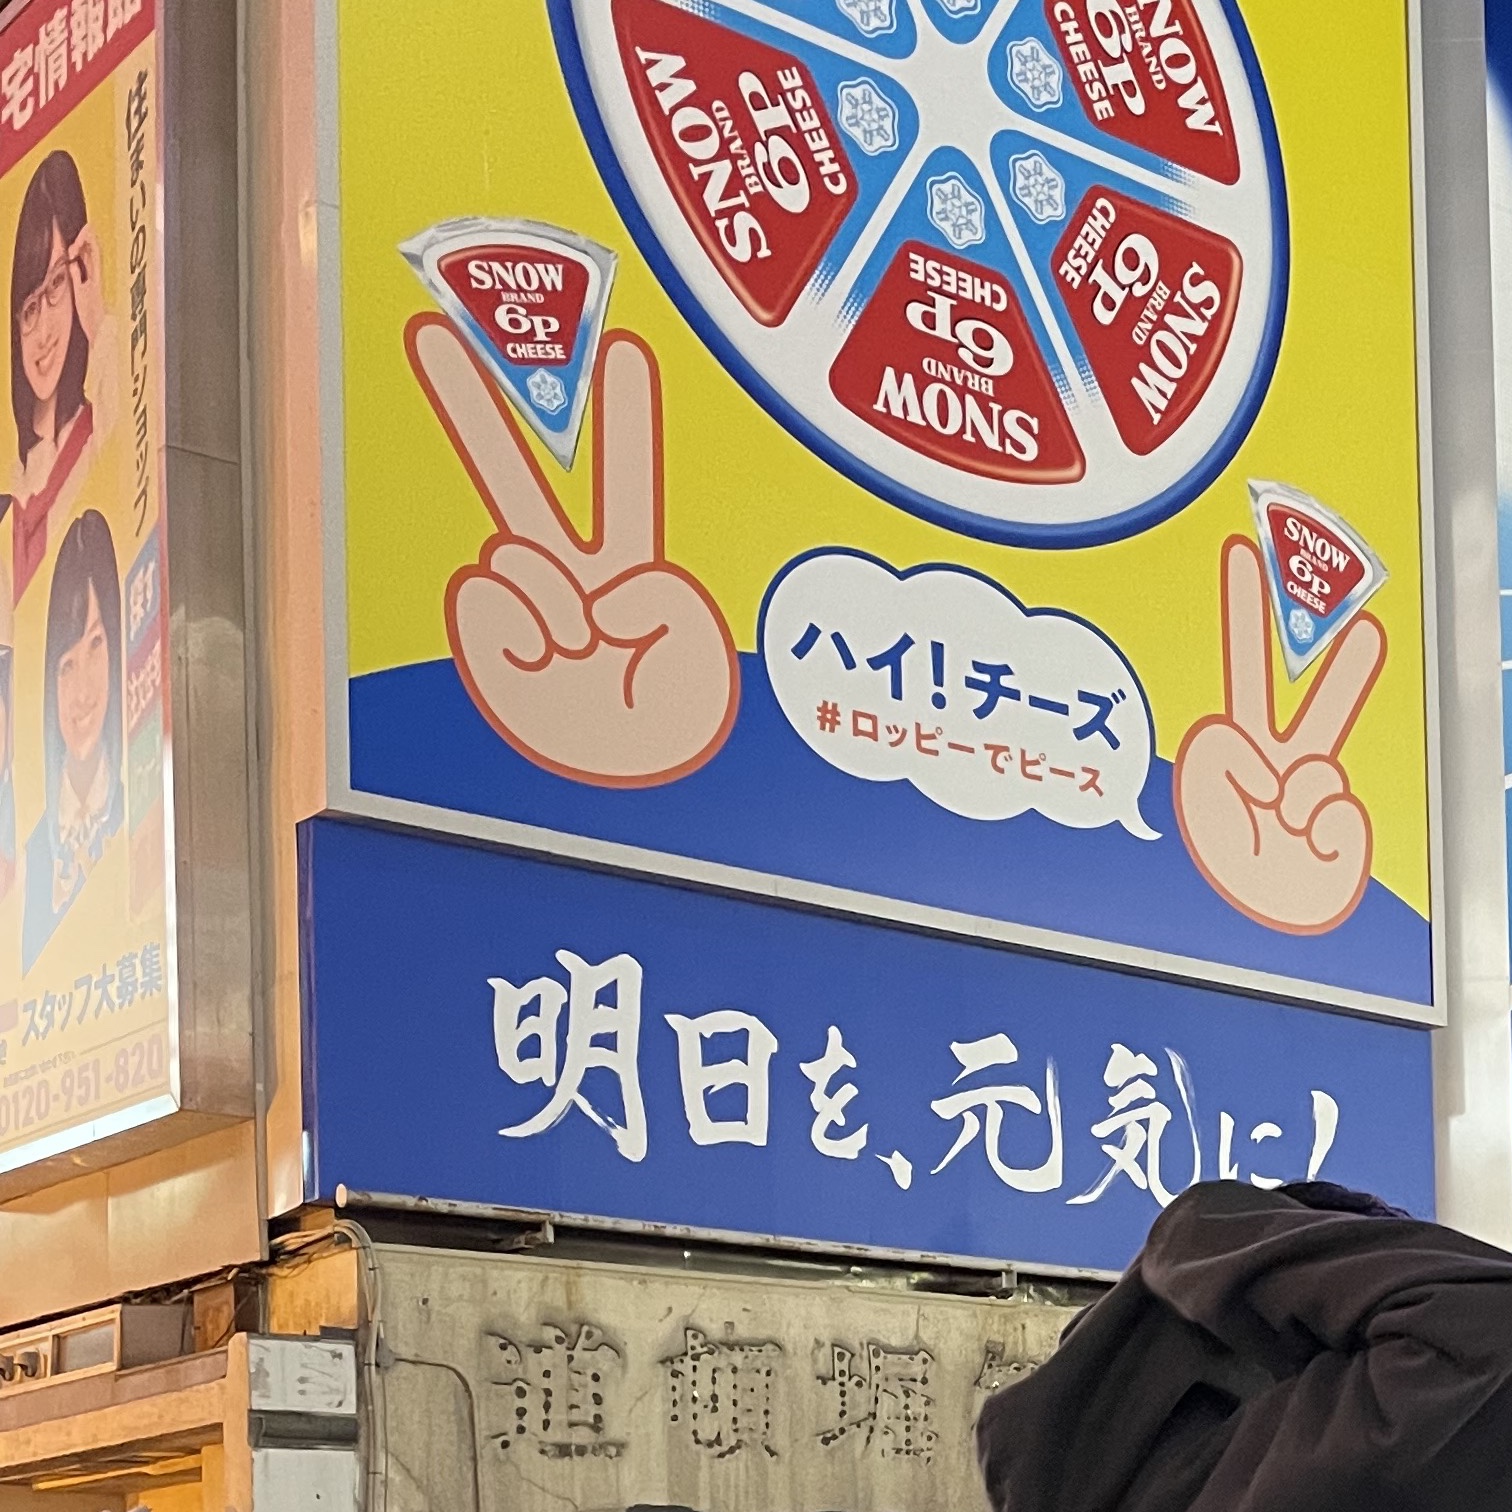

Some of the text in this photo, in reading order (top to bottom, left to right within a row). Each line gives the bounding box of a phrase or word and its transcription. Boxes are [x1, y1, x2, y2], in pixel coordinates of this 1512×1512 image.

[1054, 1, 1115, 121] CHEESE
[1086, 0, 1146, 116] 6P
[1124, 5, 1167, 91] BRAND
[635, 46, 773, 263] SNOW
[711, 100, 764, 196] BRAND
[738, 71, 812, 214] 6P
[776, 65, 846, 196] CHEESE
[467, 260, 564, 292] SNOW
[907, 251, 1008, 312] CHEESE
[1058, 196, 1116, 289] CHEESE
[1091, 233, 1161, 326] 6P
[494, 303, 560, 341] 6P
[500, 290, 545, 304] BRAND
[905, 290, 1014, 377] 6P
[1130, 279, 1171, 346] BRAND
[506, 343, 567, 359] CHEESE
[921, 356, 995, 397] BRAND
[1129, 261, 1221, 426] SNOW
[872, 365, 1040, 463] SNOW
[1283, 516, 1351, 573] SNOW
[1288, 555, 1331, 598] 6P
[1299, 548, 1329, 572] BRAND
[1286, 581, 1327, 615] CHEESE
[790, 621, 1128, 751] ハイ！チーズ
[816, 699, 1105, 798] #ロッピーでピース
[21, 941, 164, 1048] スタッフ大募集
